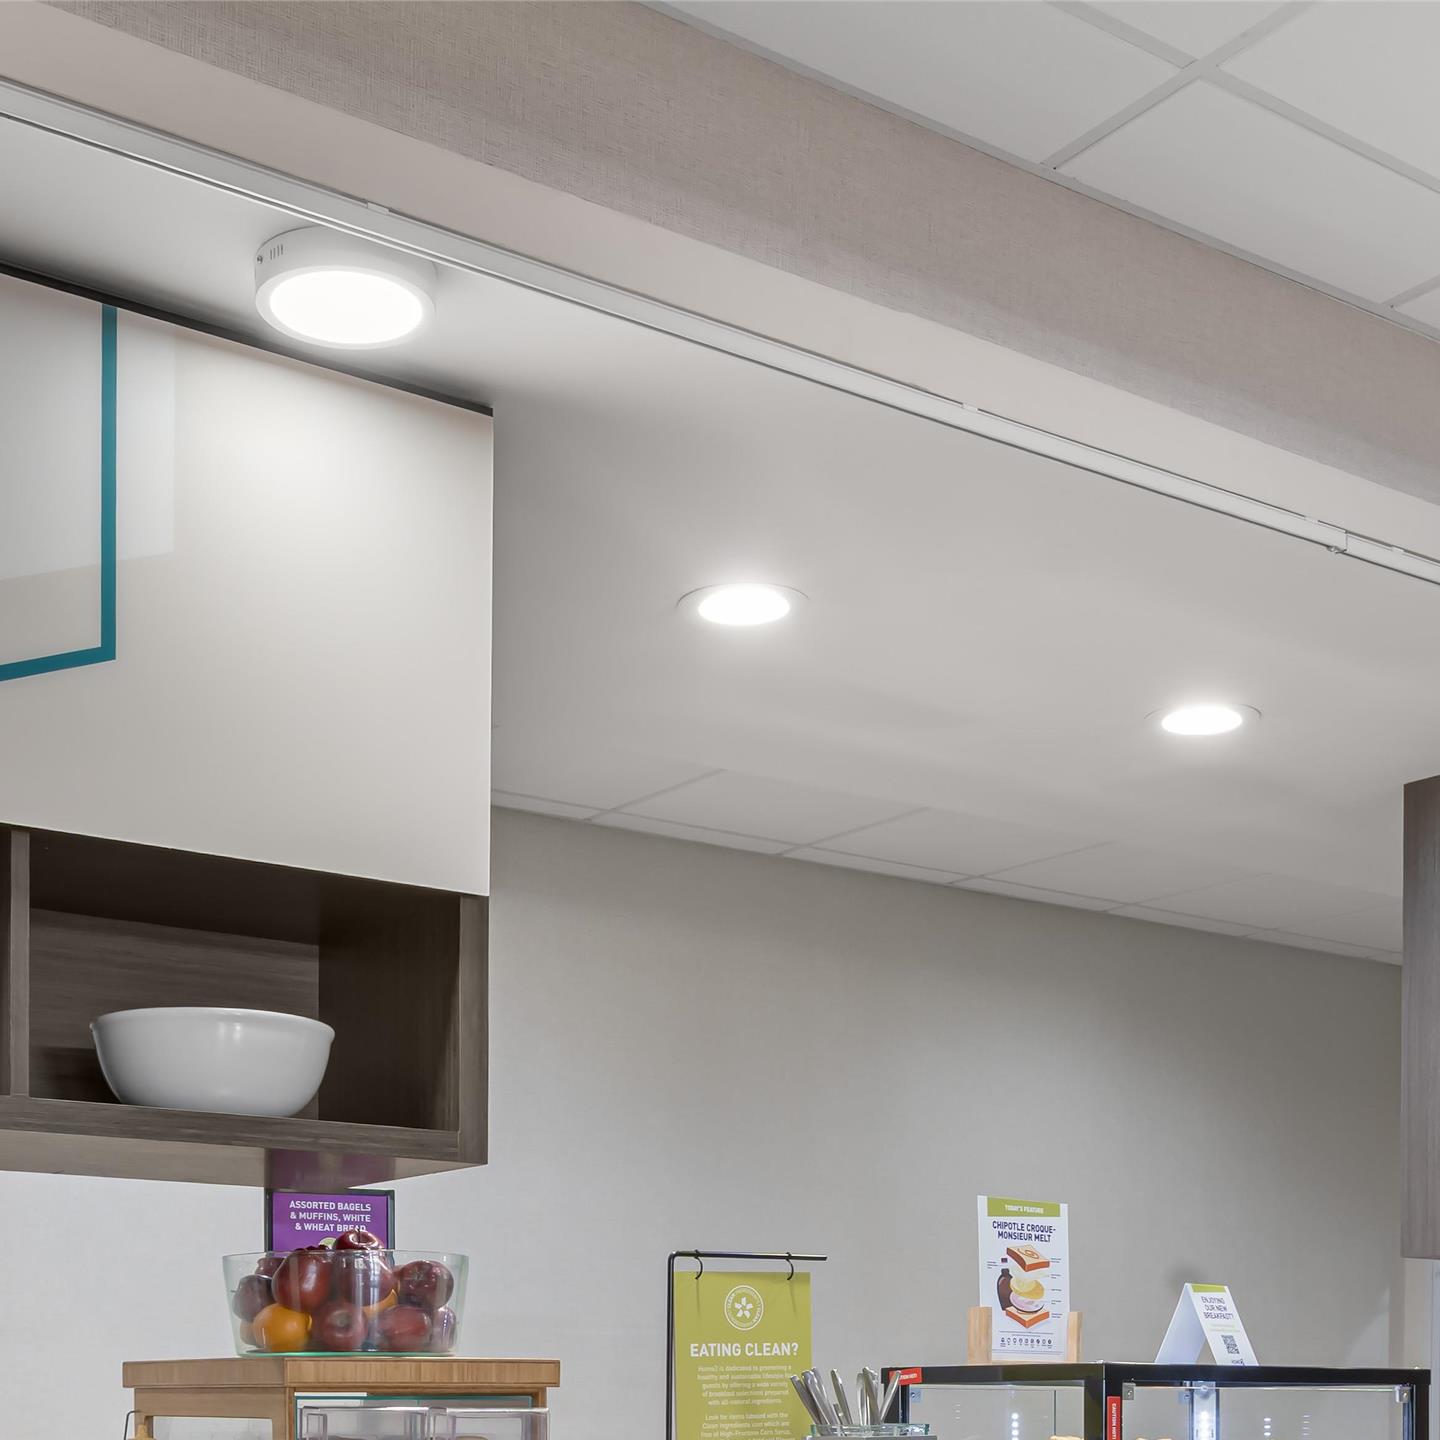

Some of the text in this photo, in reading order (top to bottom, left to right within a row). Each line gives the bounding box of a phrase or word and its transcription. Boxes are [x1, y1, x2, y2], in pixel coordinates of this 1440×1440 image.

[289, 1200, 372, 1212] ASSORTED BAGELS
[290, 1212, 371, 1222] & MUFFINS, WHITE
[295, 1222, 302, 1231] &
[304, 1223, 334, 1232] WHEAT
[992, 1220, 1056, 1234] CHIPOTLE CROQUE-
[997, 1230, 1052, 1242] MONSIEUR MELT
[690, 1342, 799, 1358] EATING CLEAN?
